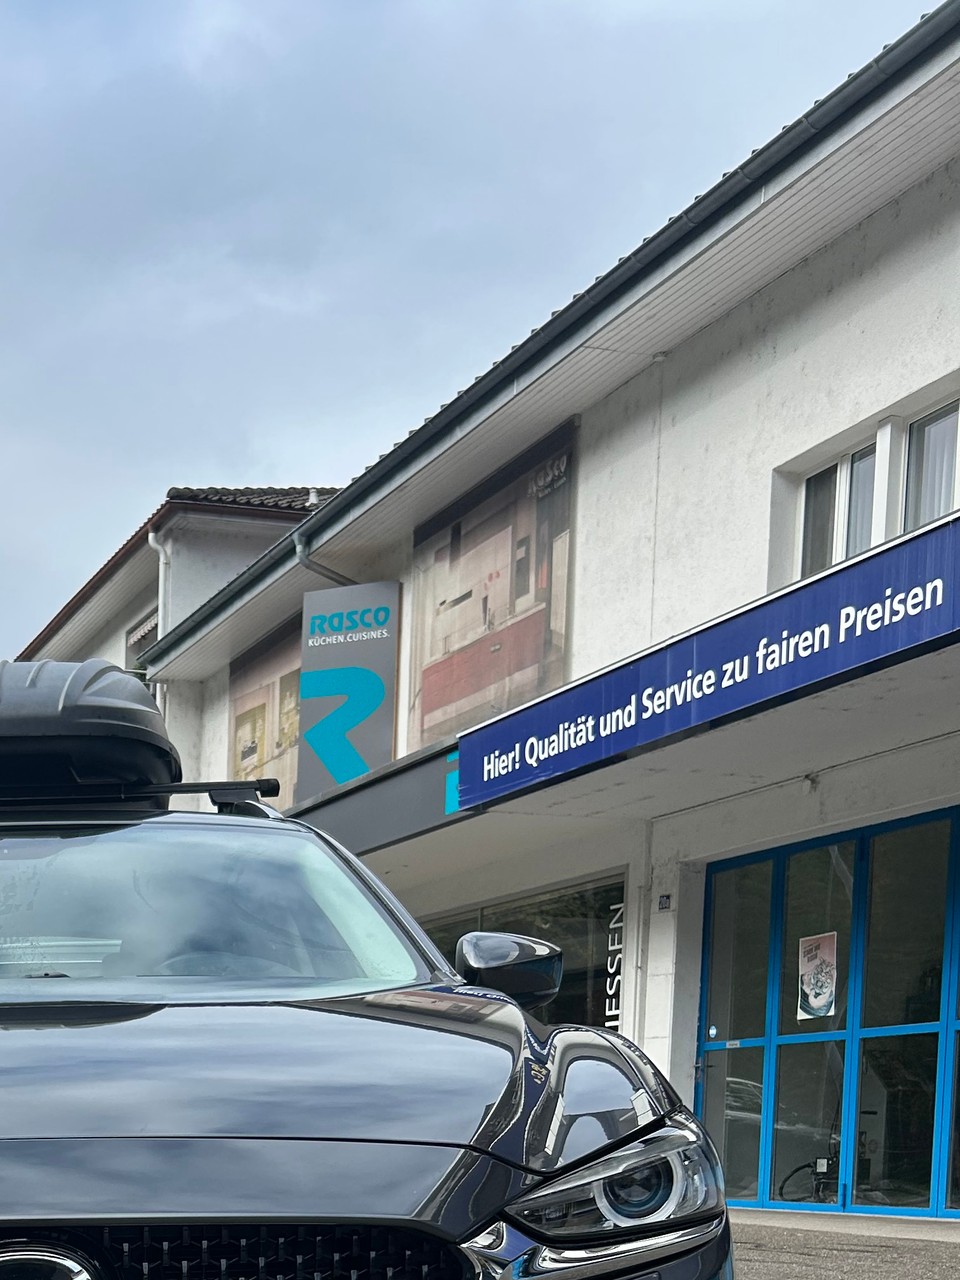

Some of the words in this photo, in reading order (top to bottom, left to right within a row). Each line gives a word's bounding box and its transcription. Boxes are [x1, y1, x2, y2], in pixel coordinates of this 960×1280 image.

[483, 743, 520, 781] Hier!
[524, 715, 595, 766] Qualität
[599, 694, 636, 737] und
[642, 669, 715, 719] Service
[722, 655, 748, 689] zu
[756, 623, 829, 675] fairen
[839, 577, 943, 643] Preisen
